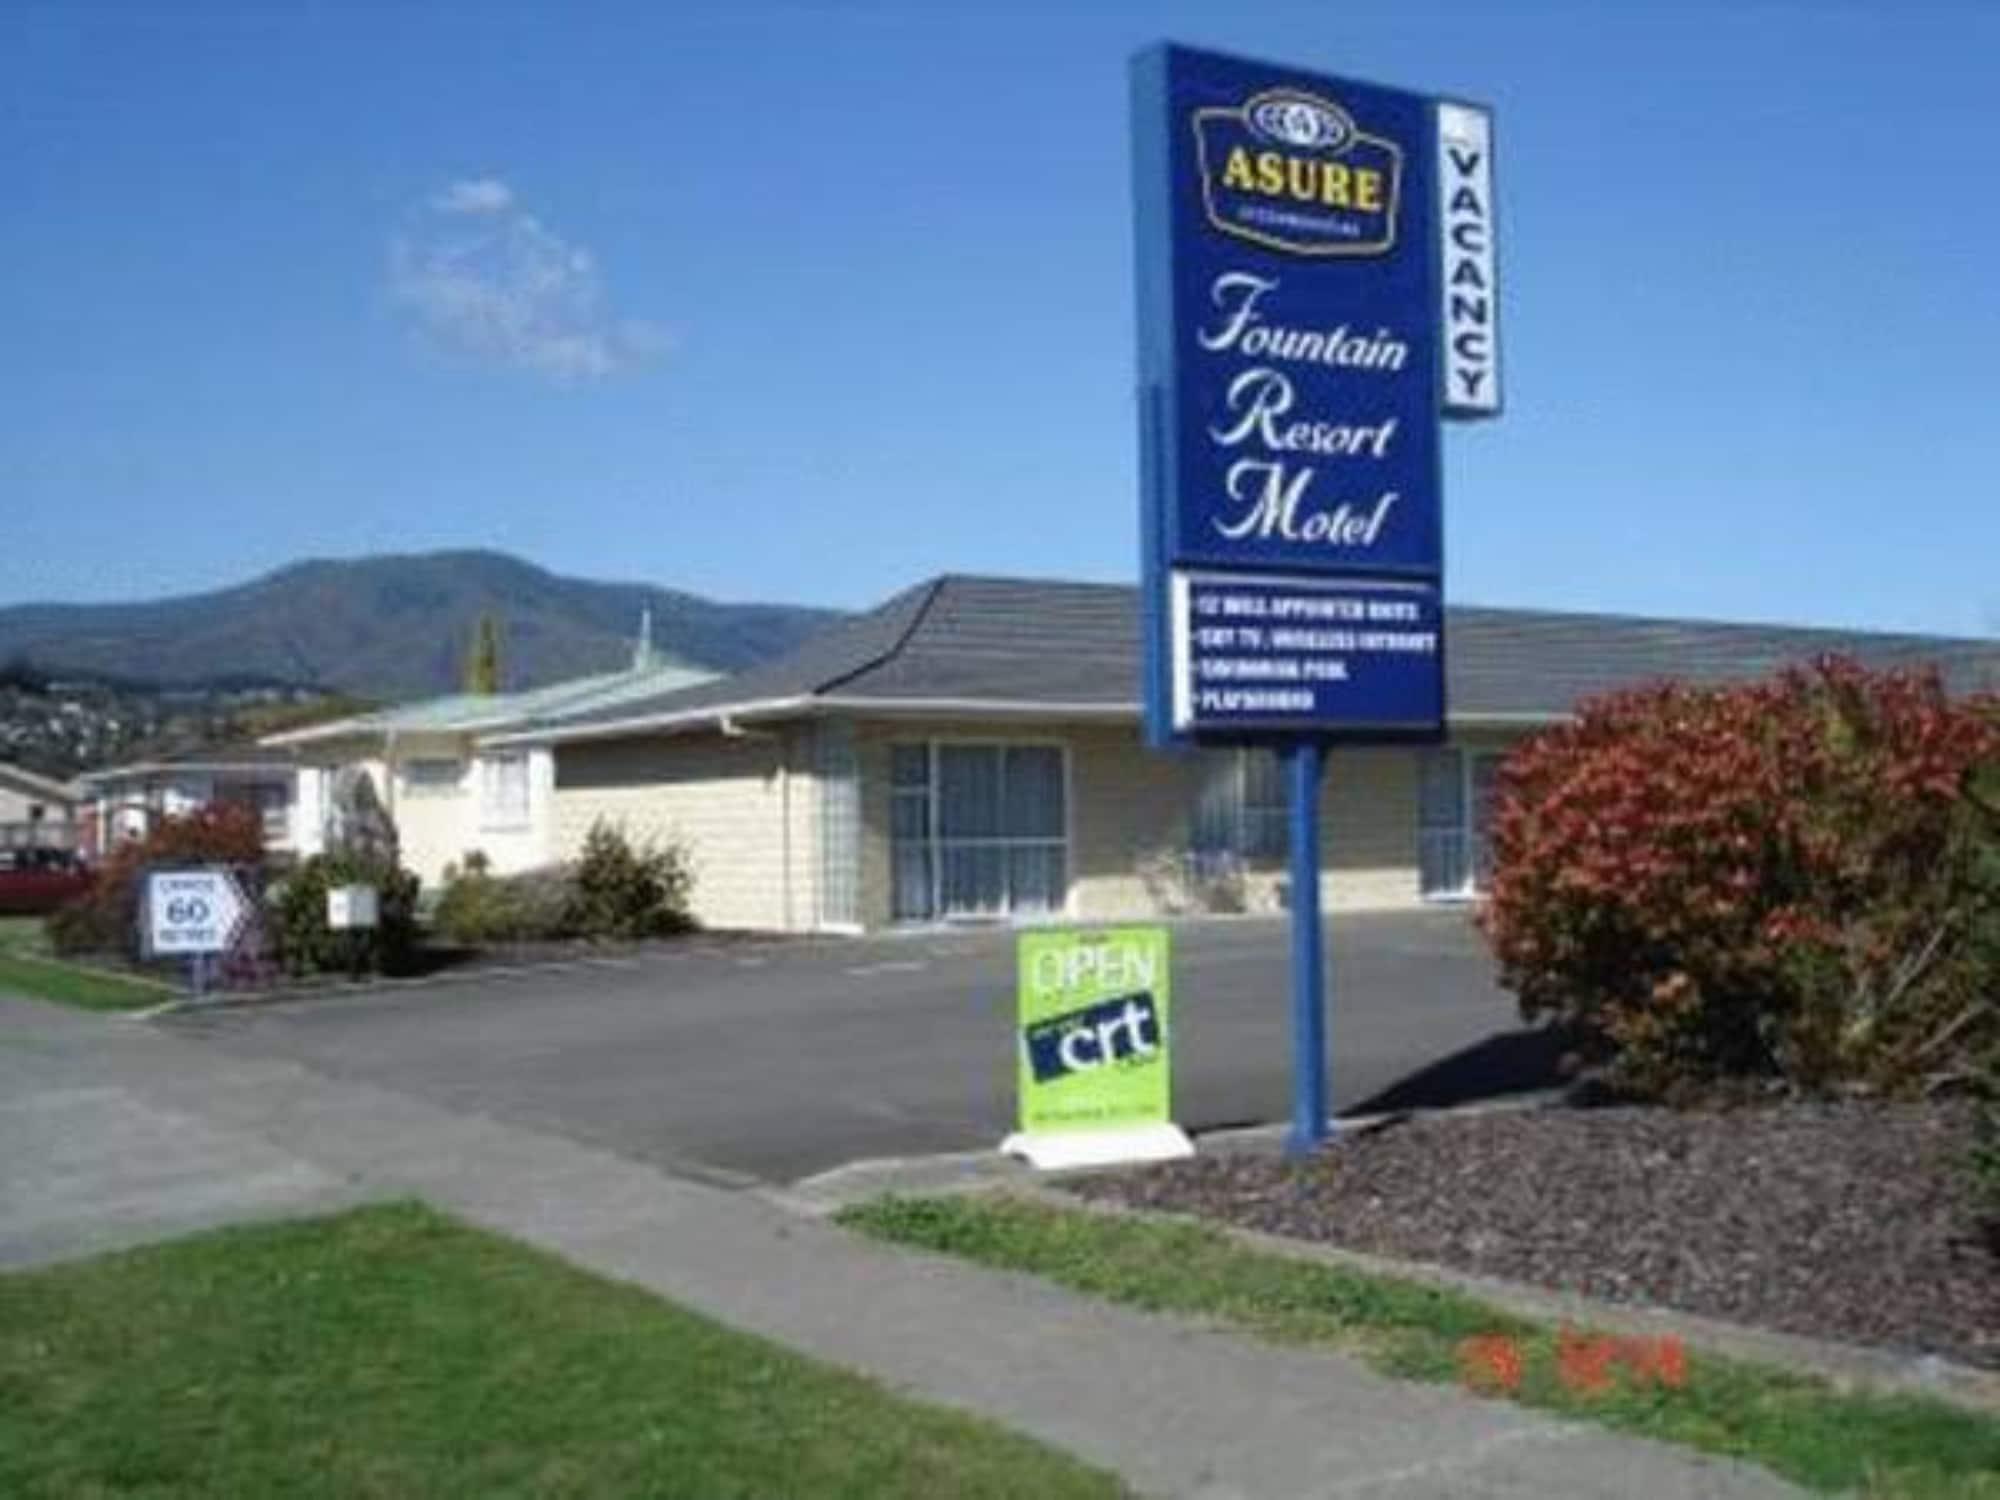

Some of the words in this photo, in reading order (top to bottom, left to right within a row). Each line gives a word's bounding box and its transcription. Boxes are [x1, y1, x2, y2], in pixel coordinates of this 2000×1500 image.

[1221, 146, 1382, 212] ASURE
[1449, 147, 1487, 397] VACANCY
[1197, 272, 1408, 370] Fountain
[1208, 367, 1398, 458] Resort
[1211, 459, 1399, 546] Motel
[166, 896, 210, 924] 60
[1033, 945, 1156, 990] OPEN
[1059, 1001, 1156, 1070] crt
